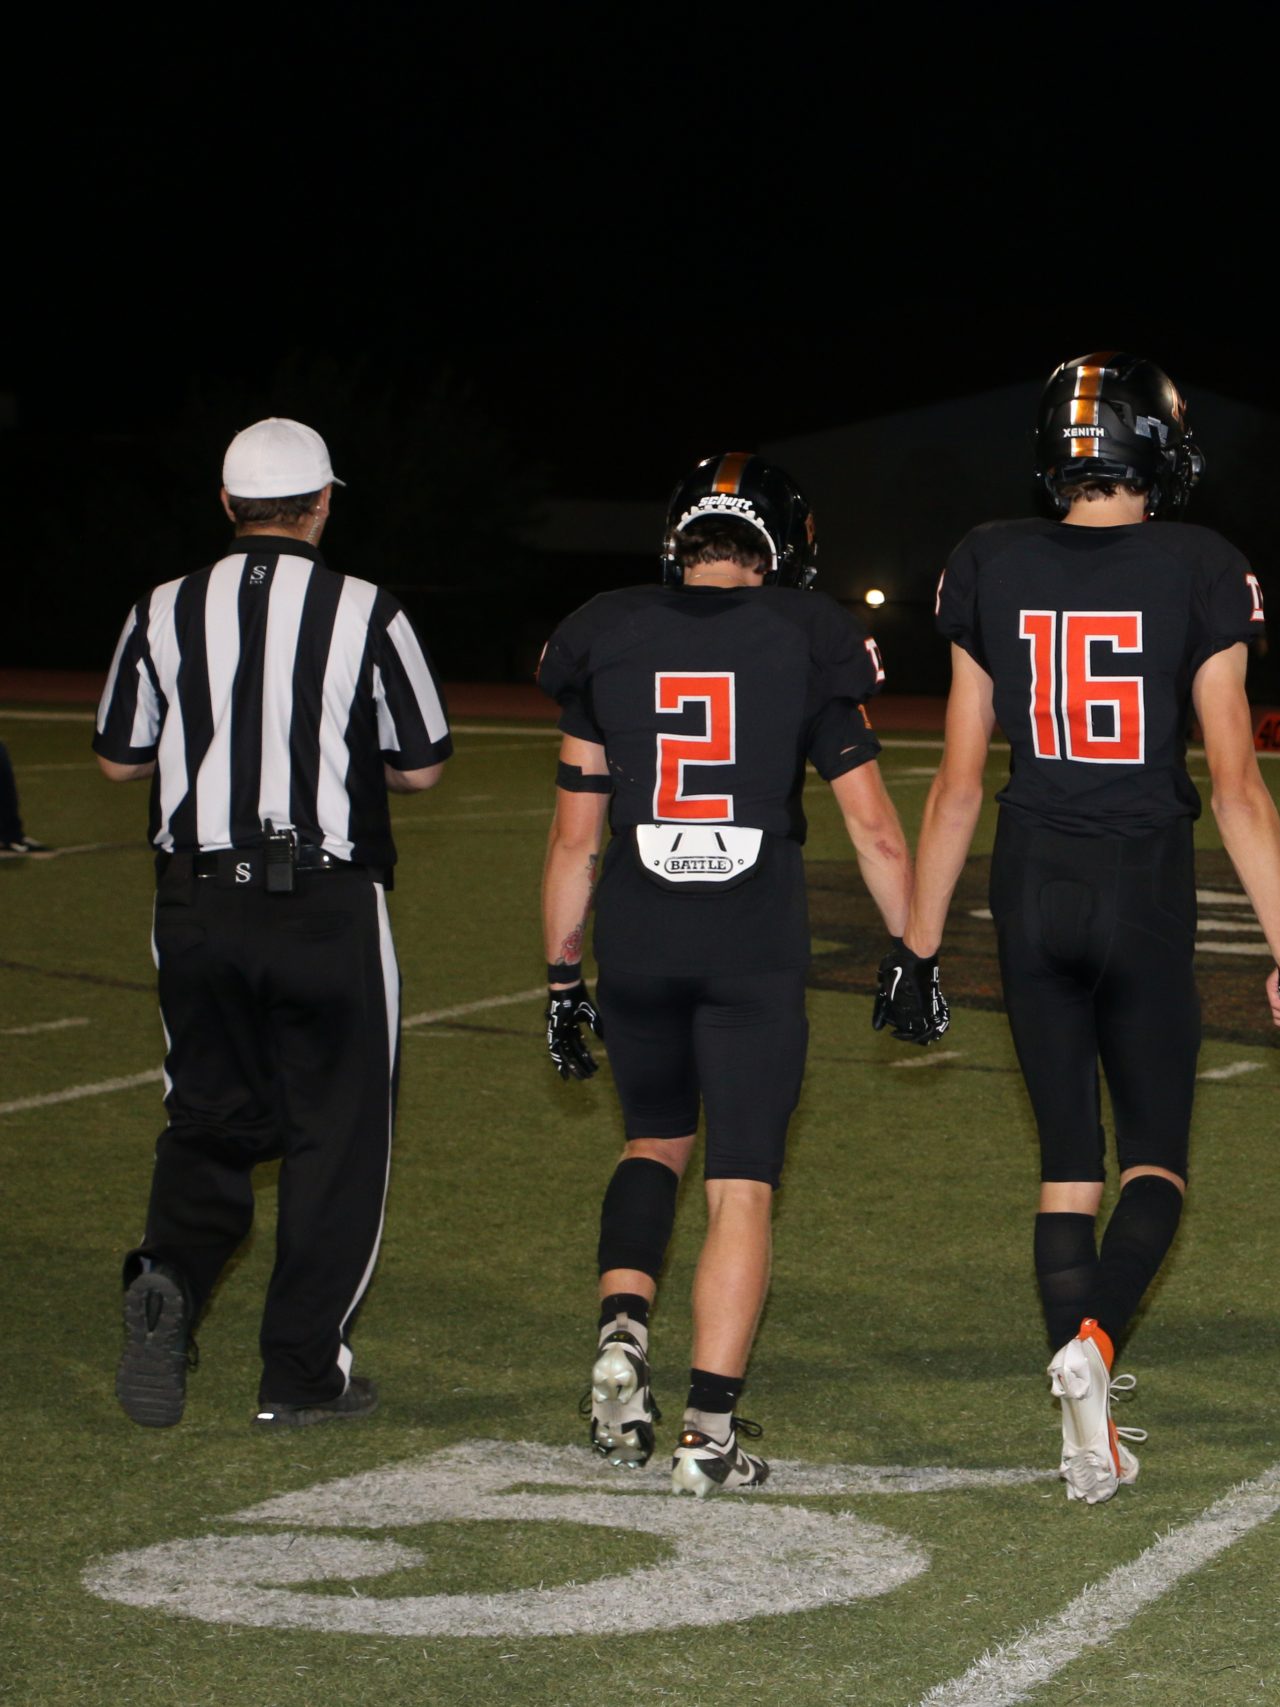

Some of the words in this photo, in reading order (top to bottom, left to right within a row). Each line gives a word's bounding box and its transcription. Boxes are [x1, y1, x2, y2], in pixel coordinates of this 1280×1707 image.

[1063, 427, 1105, 437] XENITH
[1019, 610, 1145, 764] 16
[653, 672, 736, 822] 2
[670, 859, 728, 871] BATTLE
